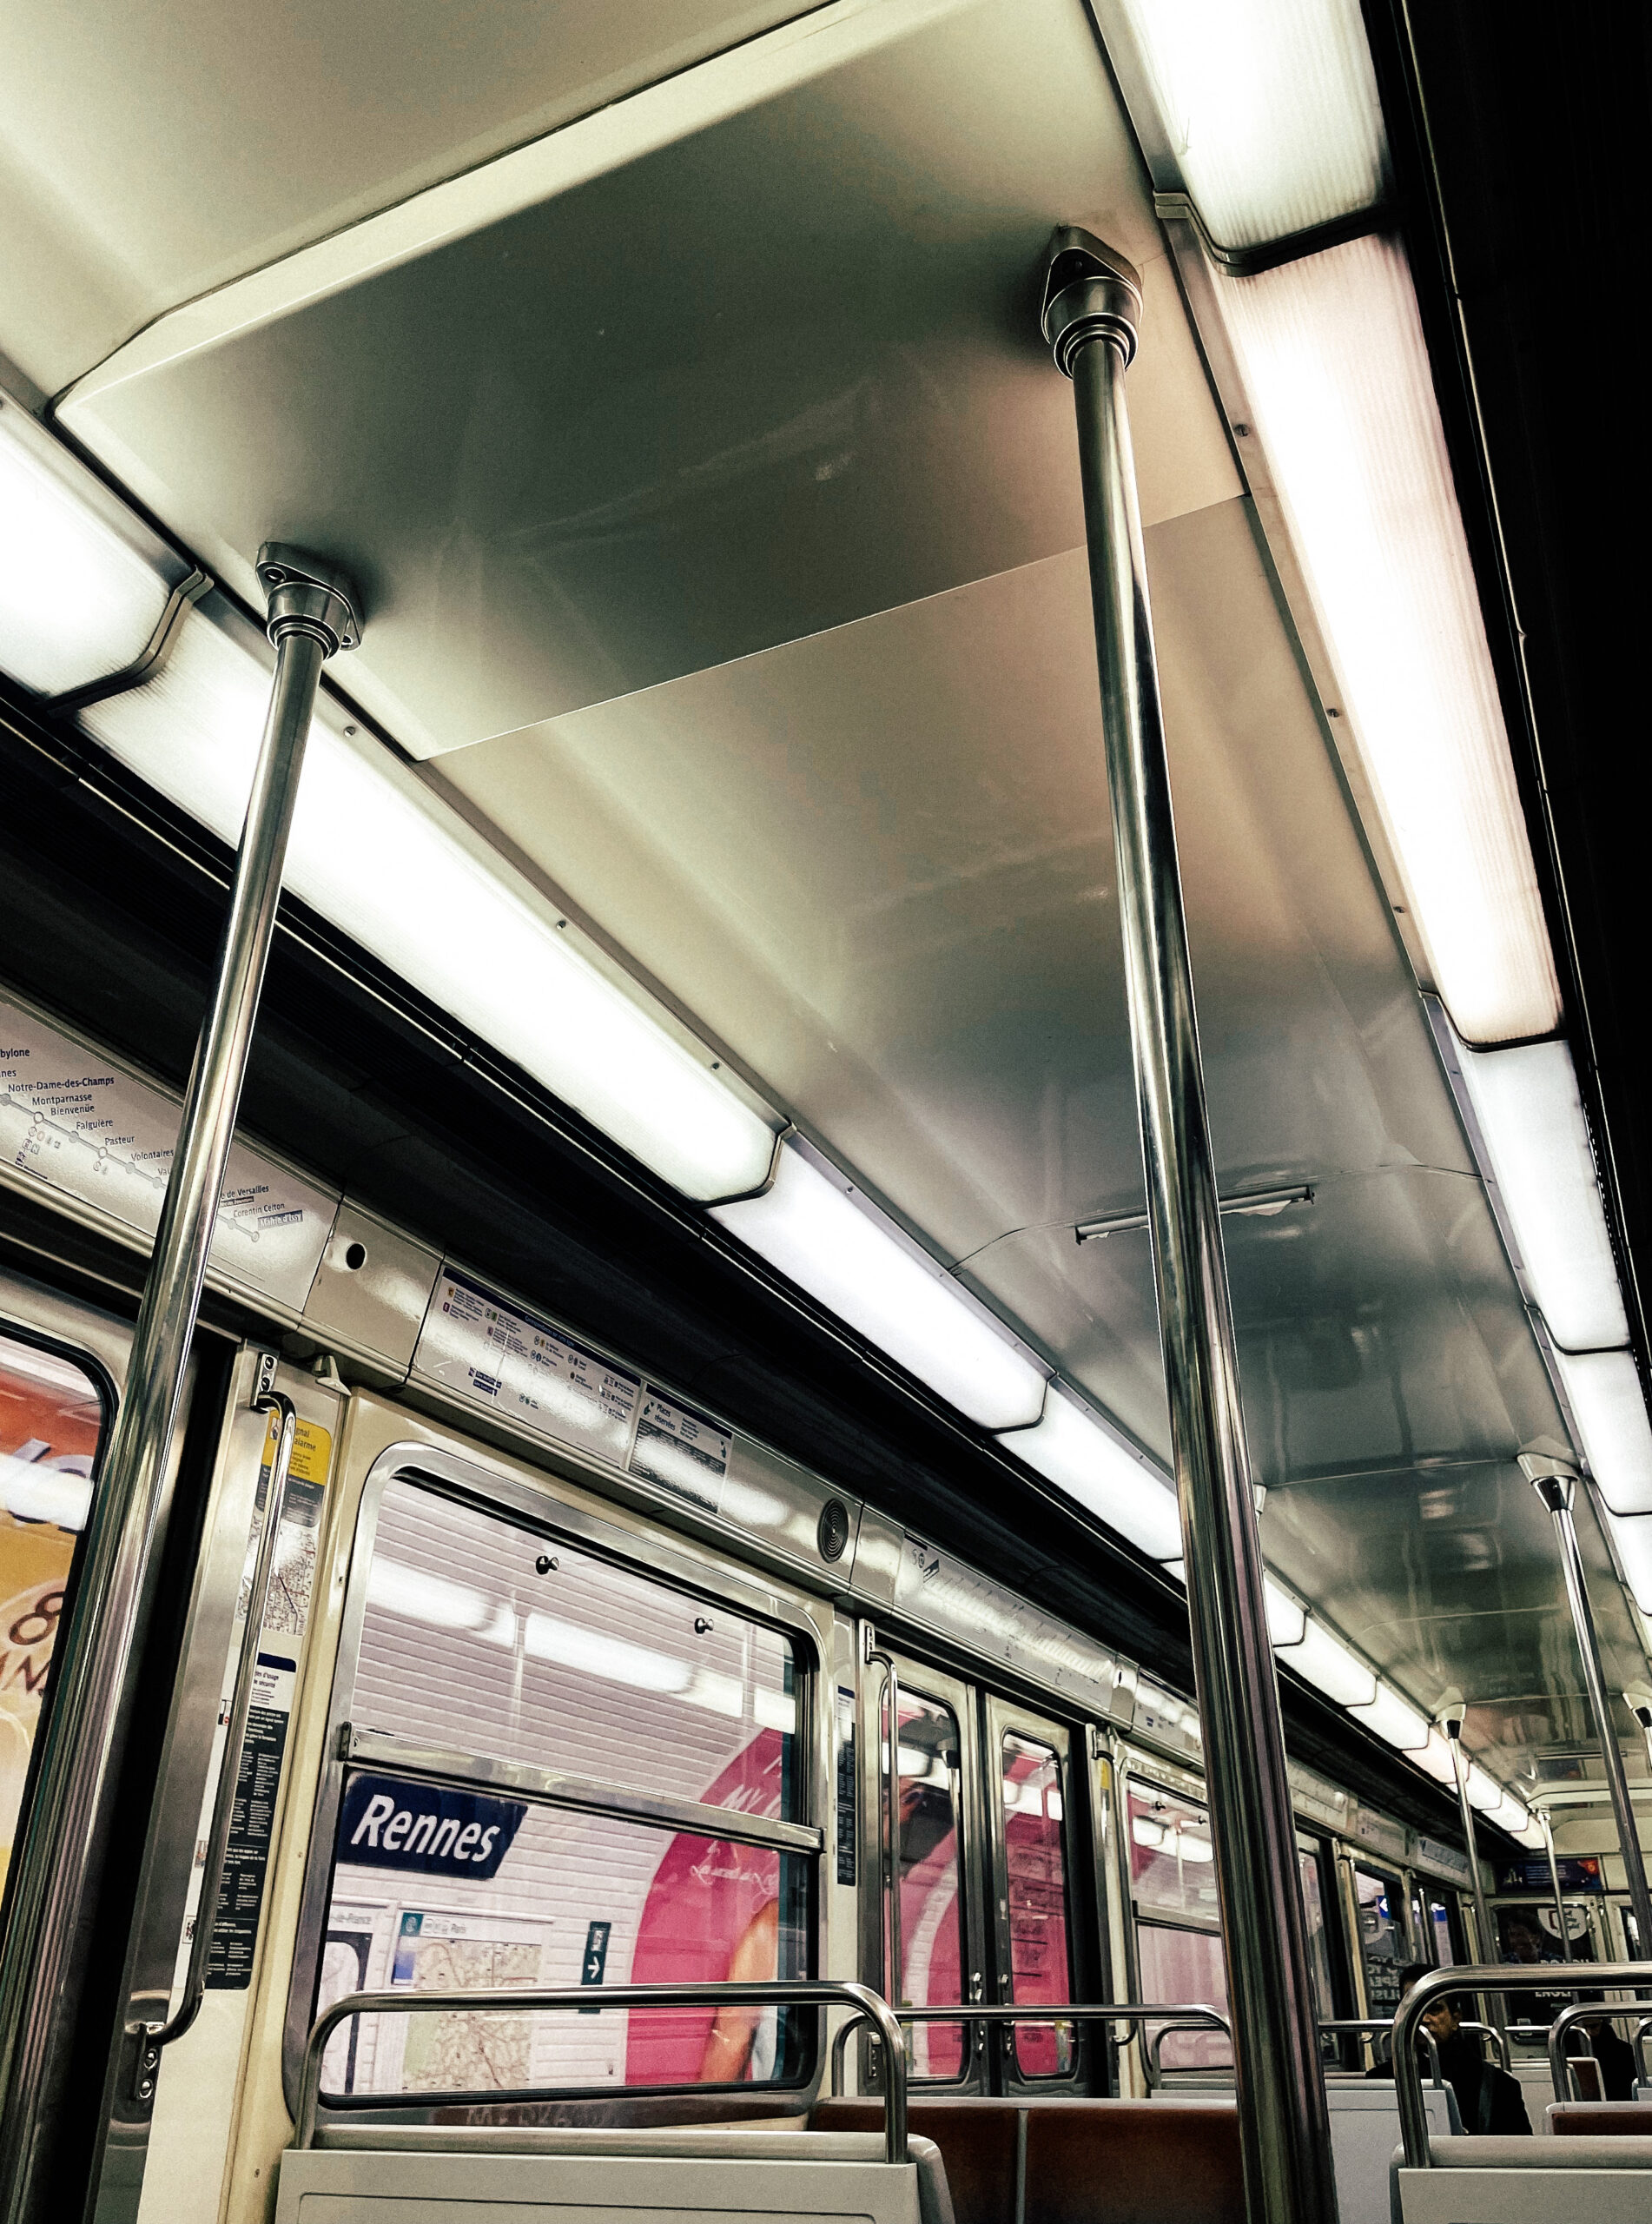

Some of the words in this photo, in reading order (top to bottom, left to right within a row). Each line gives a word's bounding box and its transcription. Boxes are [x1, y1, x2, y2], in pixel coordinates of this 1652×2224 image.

[8, 1077, 115, 1092] Notre-Dame-des-Champs
[32, 1094, 92, 1106] Montparnasse
[76, 1119, 114, 1130] Falguière
[104, 1135, 135, 1146] Pasteur
[130, 1148, 174, 1162] Volontaires
[237, 1185, 269, 1196] Versailles
[234, 1207, 262, 1218] Corentin
[263, 1202, 285, 1213] Celton
[351, 1794, 501, 1863] Rennes
